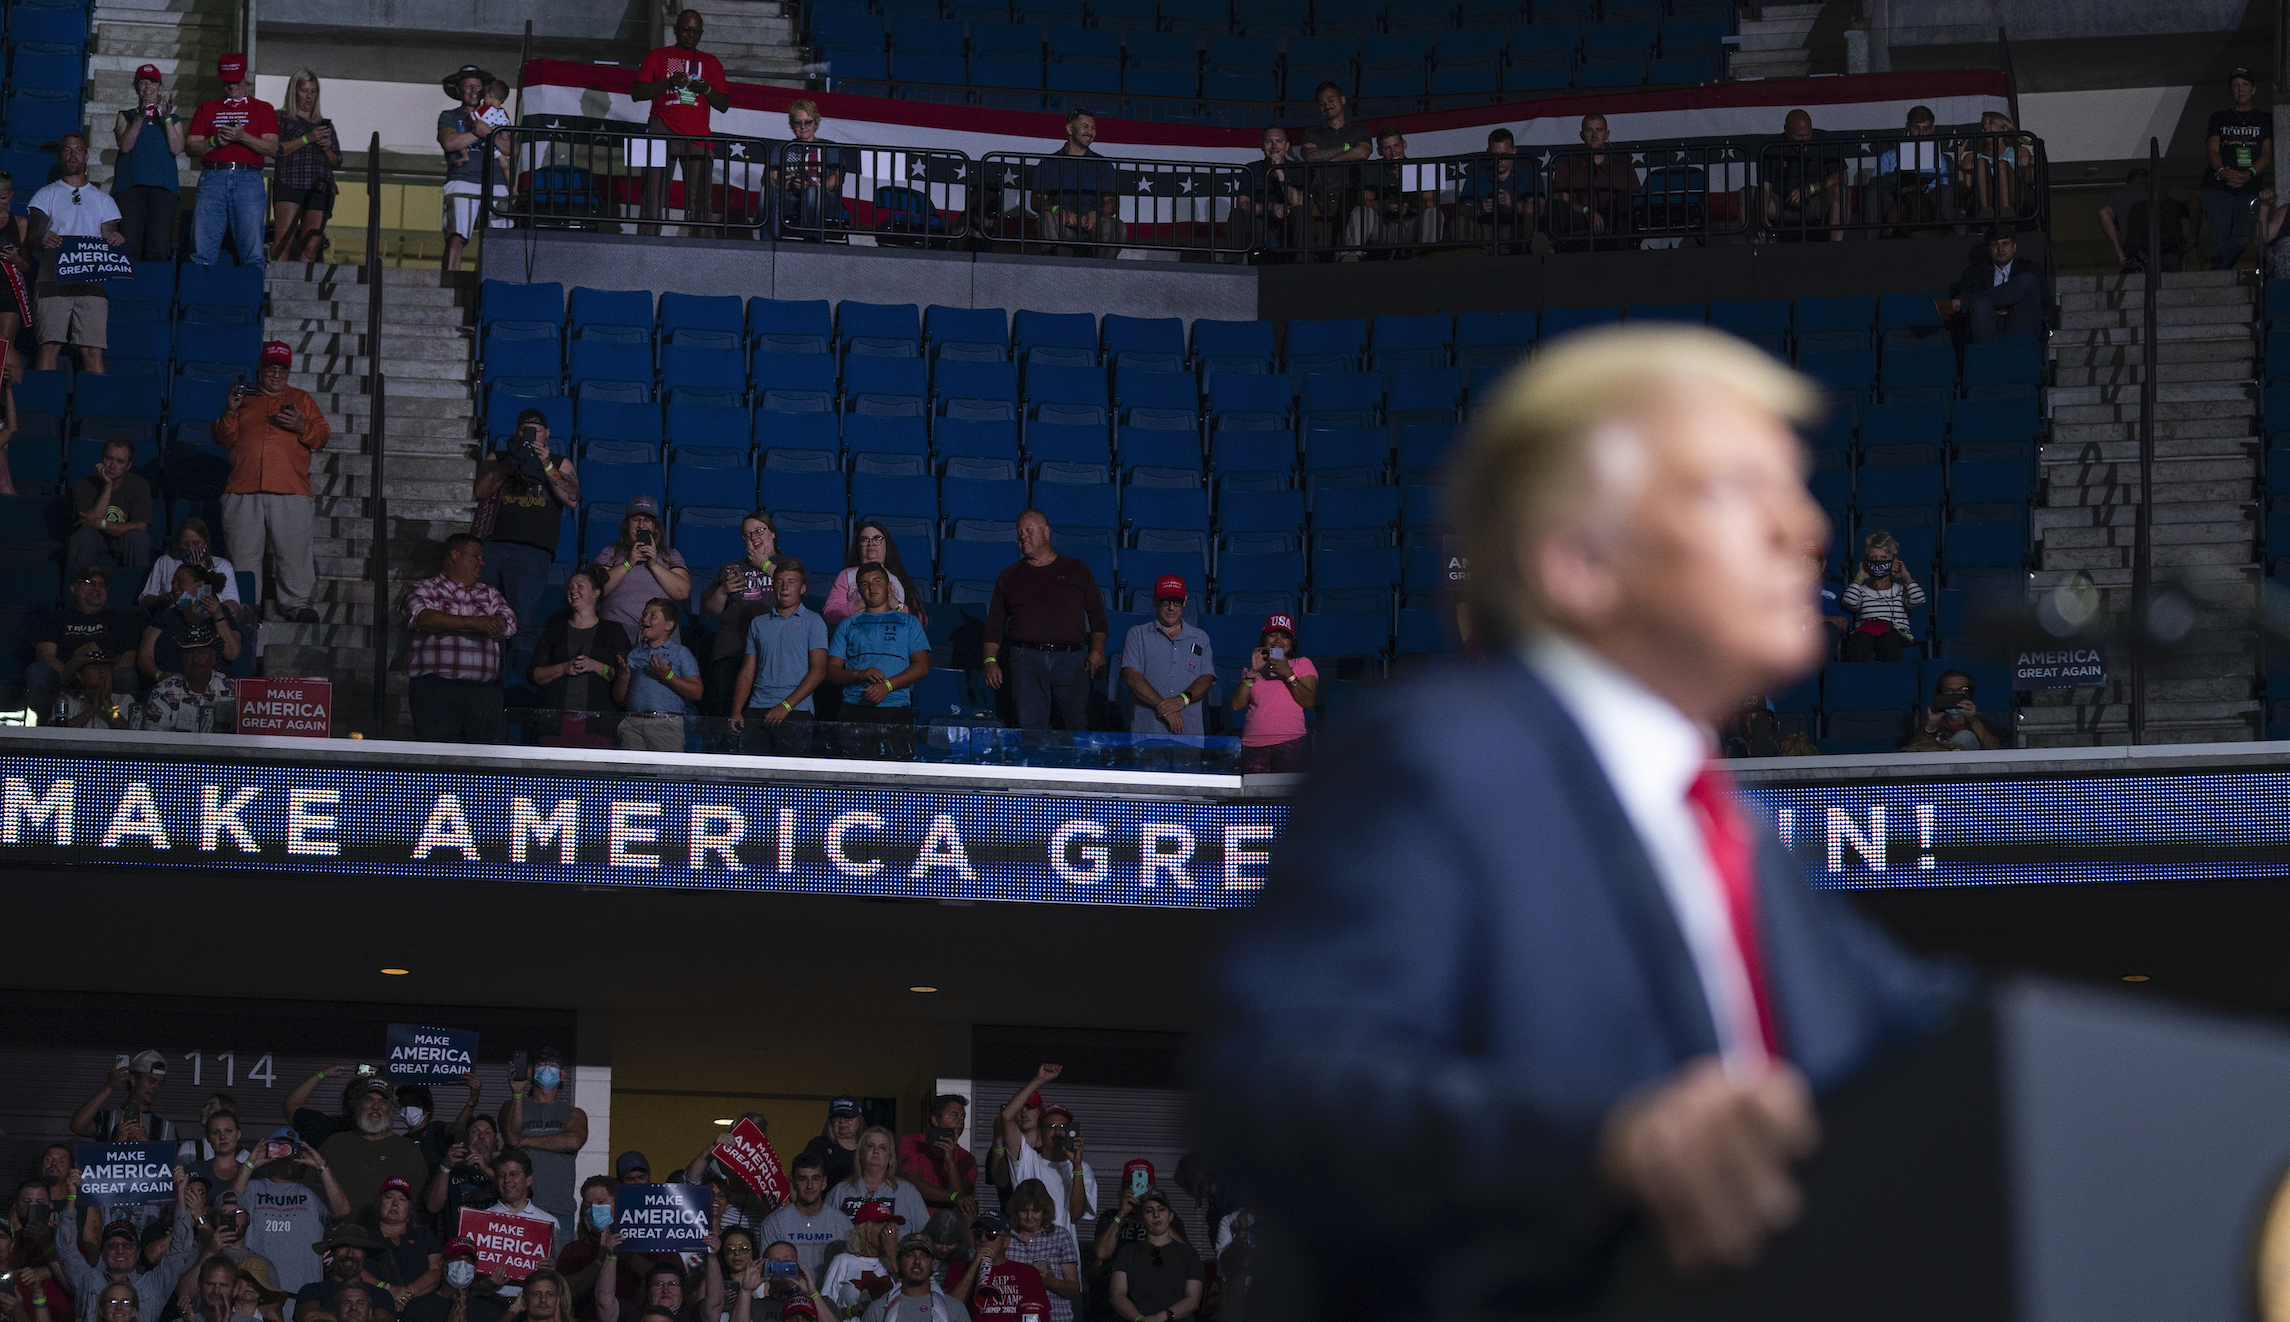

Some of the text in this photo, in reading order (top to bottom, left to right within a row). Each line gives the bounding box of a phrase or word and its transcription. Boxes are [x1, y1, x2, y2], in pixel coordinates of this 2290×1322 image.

[2220, 126, 2260, 137] Trump
[78, 242, 110, 251] MAKE
[58, 252, 130, 264] AMERICA
[59, 264, 132, 275] GREAT AGAIN
[66, 624, 104, 632] TRUMP
[1271, 616, 1292, 630] USA
[2018, 649, 2100, 665] AMERICA
[2018, 665, 2101, 678] GREAT AGAIN
[268, 689, 302, 700] MAKE
[242, 701, 326, 718] AMERICA
[242, 718, 326, 731] GREAT AGAIN
[2, 777, 341, 856] MAKE
[411, 793, 976, 881] AMERICA
[1048, 820, 1273, 891] GRE
[415, 1035, 450, 1046] MAKE
[391, 1047, 471, 1063] AMERICA
[185, 1050, 276, 1088] 114
[390, 1063, 470, 1074] GREAT AGAIN
[107, 1151, 146, 1161] MAKE
[756, 1142, 778, 1174] MAKE
[81, 1164, 173, 1179] AMERICA
[734, 1134, 782, 1201] AMERICA
[722, 1144, 777, 1211] GREAT AGAIN
[81, 1182, 174, 1194] GREAT AGAIN
[257, 1193, 306, 1206] TRUMP
[645, 1195, 683, 1206] MAKE
[620, 1209, 708, 1226] AMERICA
[266, 1220, 291, 1232] 2020
[489, 1222, 524, 1237] MAKE
[620, 1227, 709, 1240] GREAT AGAIN
[476, 1251, 503, 1263] EAT
